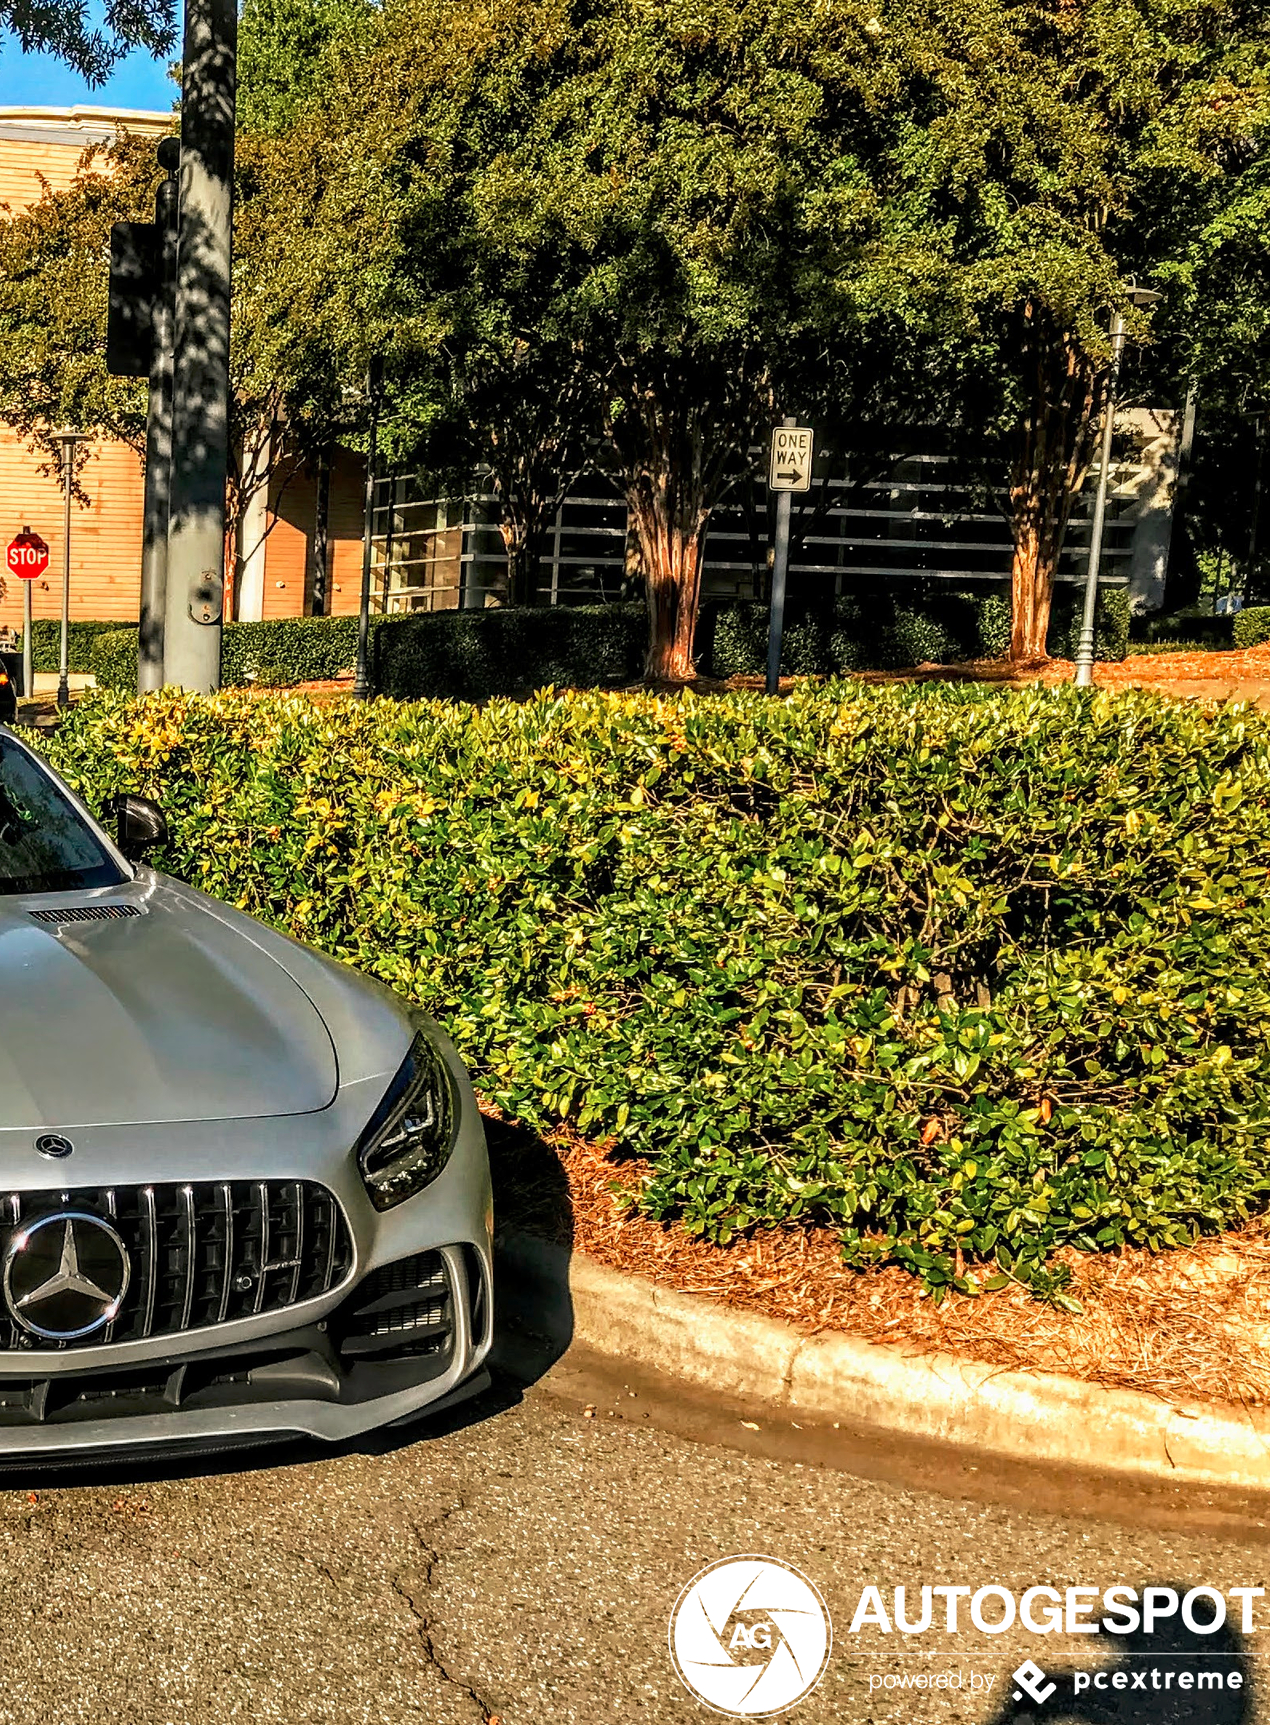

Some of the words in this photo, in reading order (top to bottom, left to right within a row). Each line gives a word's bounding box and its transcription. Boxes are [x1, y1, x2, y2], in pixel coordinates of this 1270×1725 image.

[778, 433, 807, 449] ONE
[776, 450, 807, 466] WAY
[9, 547, 47, 566] STOP
